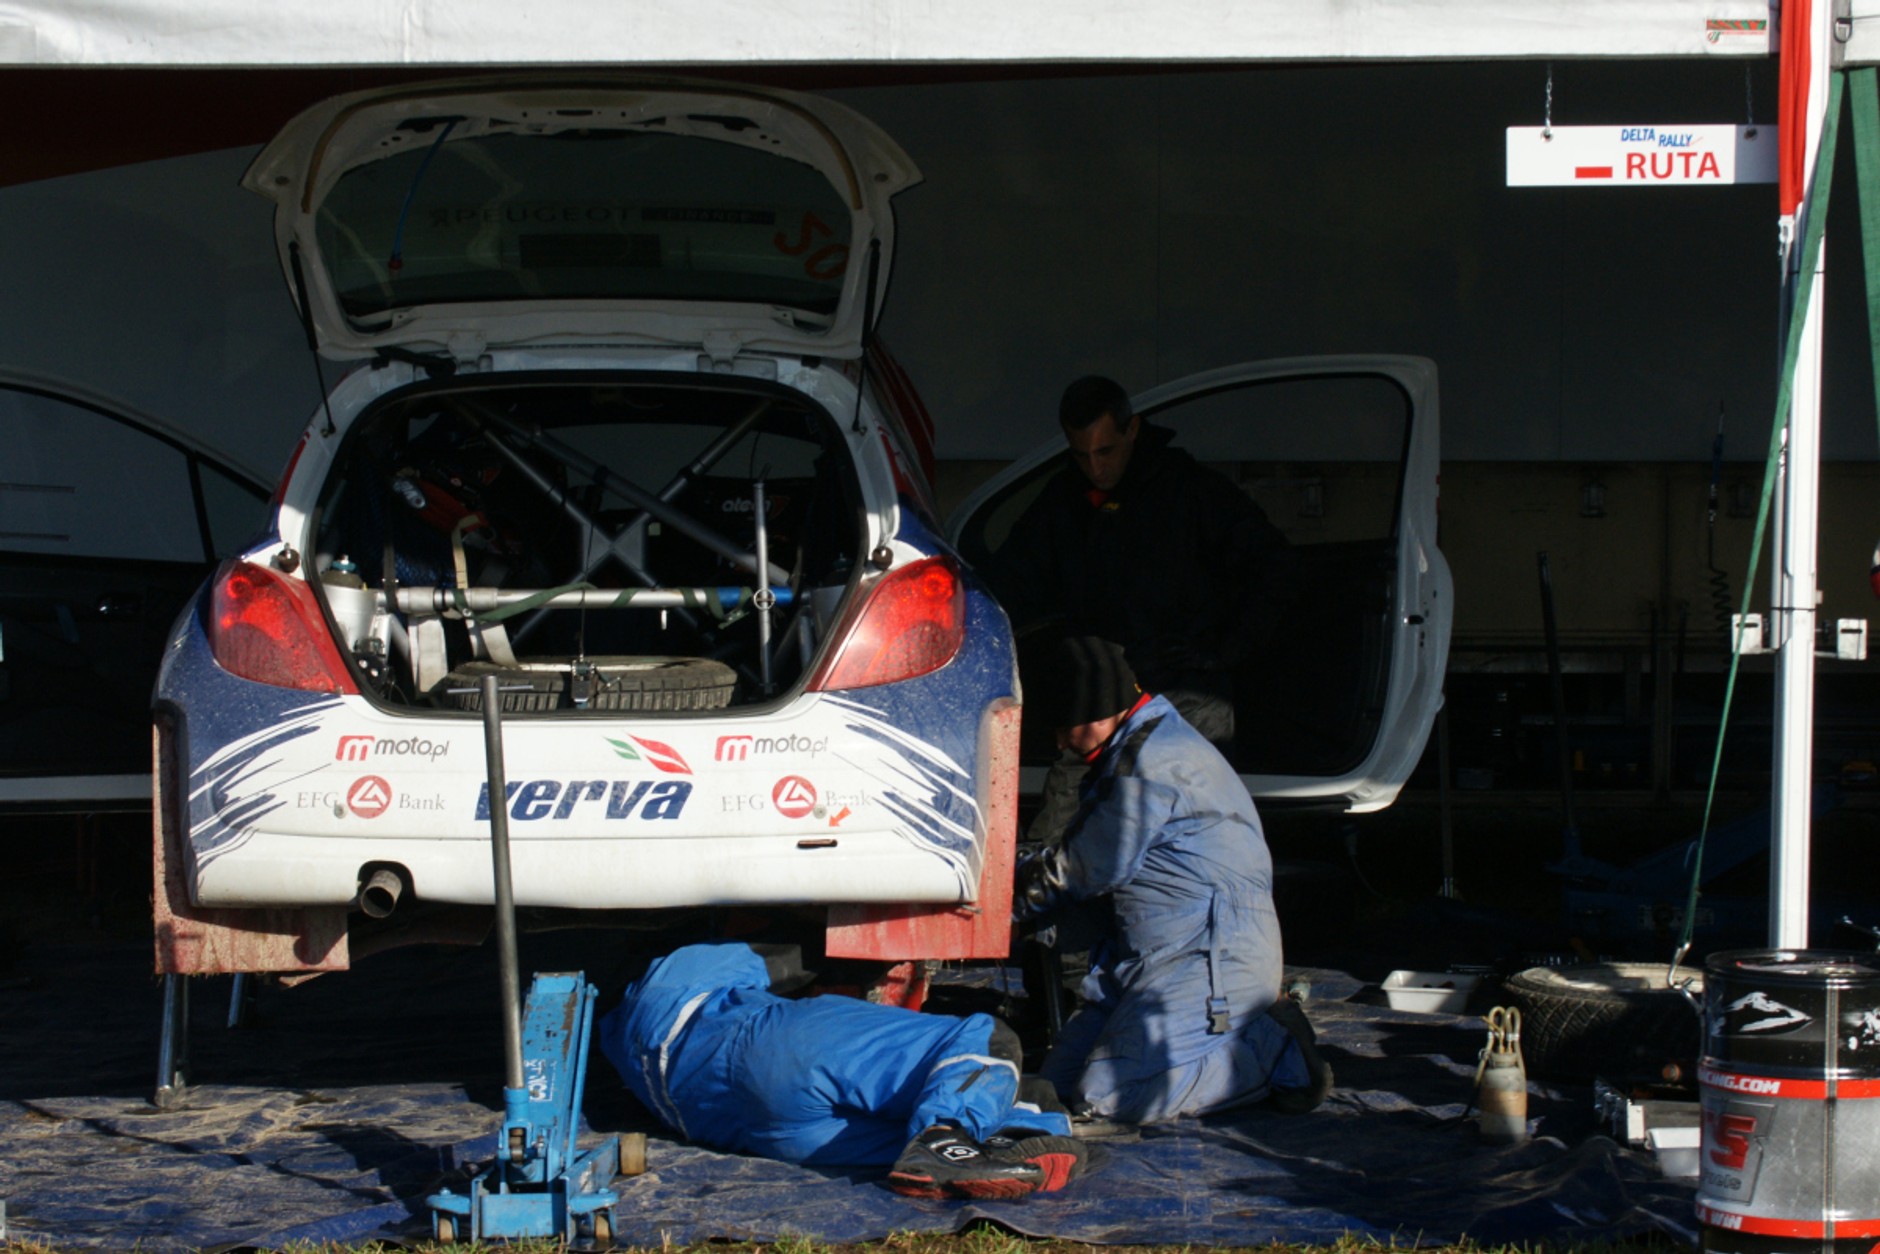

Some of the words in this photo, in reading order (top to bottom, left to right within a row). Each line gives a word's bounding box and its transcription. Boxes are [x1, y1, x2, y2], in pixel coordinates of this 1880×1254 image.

[1621, 128, 1656, 142] DELTA
[1658, 134, 1693, 148] RALLY
[1626, 151, 1721, 179] RUTA
[297, 791, 340, 809] EFG
[399, 793, 446, 810] Bank
[474, 779, 694, 821] verva
[721, 795, 765, 812] EFG
[825, 790, 873, 807] Bank
